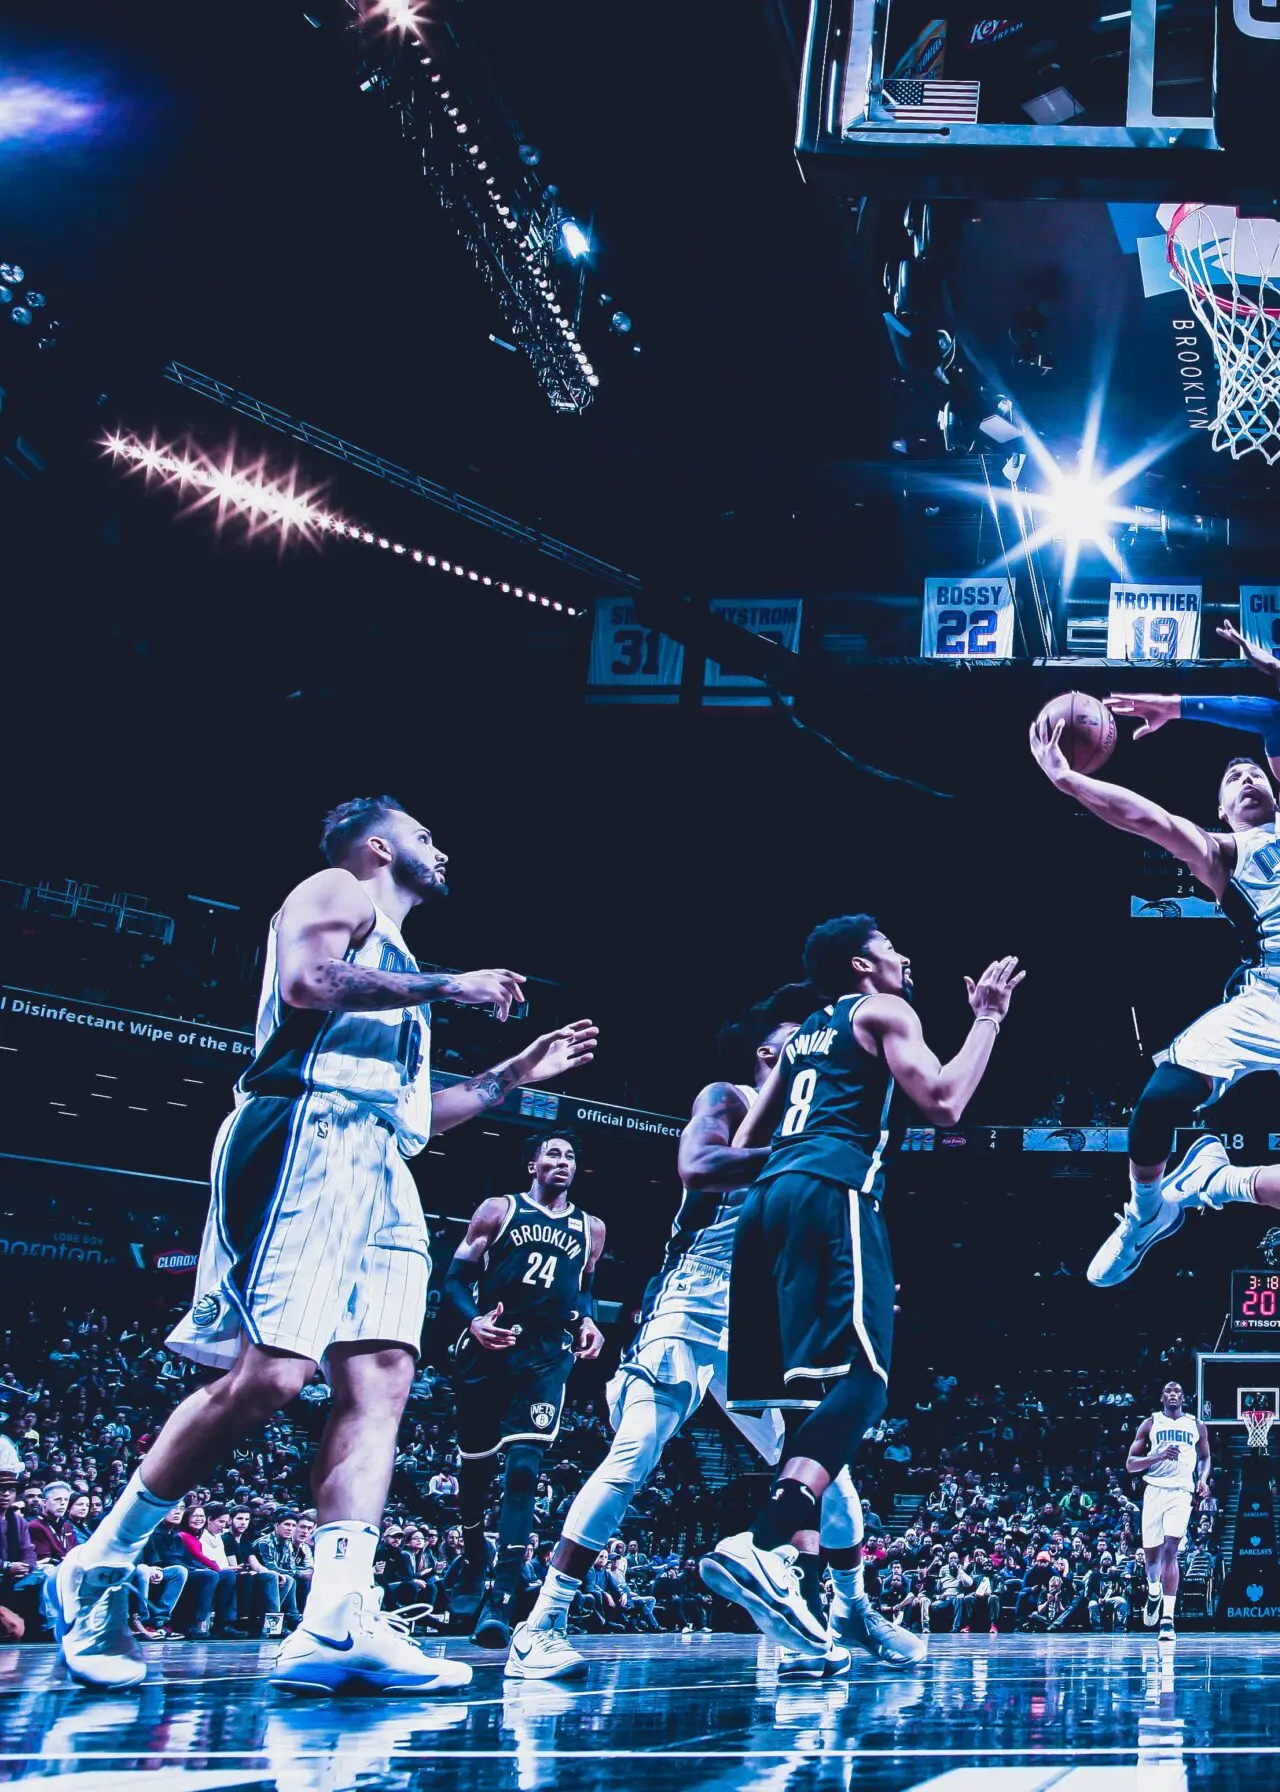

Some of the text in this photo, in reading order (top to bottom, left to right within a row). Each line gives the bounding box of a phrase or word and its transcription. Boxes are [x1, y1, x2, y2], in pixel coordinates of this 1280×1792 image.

[1172, 319, 1210, 431] BROOKLYN
[936, 585, 1004, 606] BOSSY
[1114, 591, 1199, 612] TROTTIER
[936, 609, 999, 655] 22
[1129, 616, 1179, 660] 19
[611, 619, 660, 675] 31
[11, 999, 126, 1032] Disinfectant
[129, 1021, 174, 1042] Wipe
[178, 1032, 197, 1045] of
[200, 1036, 228, 1052] the
[781, 1068, 818, 1137] 8
[576, 1107, 682, 1138] Official Disinfect
[990, 1130, 997, 1139] 2
[509, 1223, 582, 1260] BROOKLYN
[156, 1254, 199, 1269] CLOROX
[521, 1251, 558, 1289] 24
[1249, 1275, 1279, 1290] 3:18
[1242, 1290, 1276, 1316] 20
[532, 1404, 554, 1417] NETS
[1156, 1429, 1194, 1446] MAGIC
[1239, 1548, 1273, 1556] BARCLAYS
